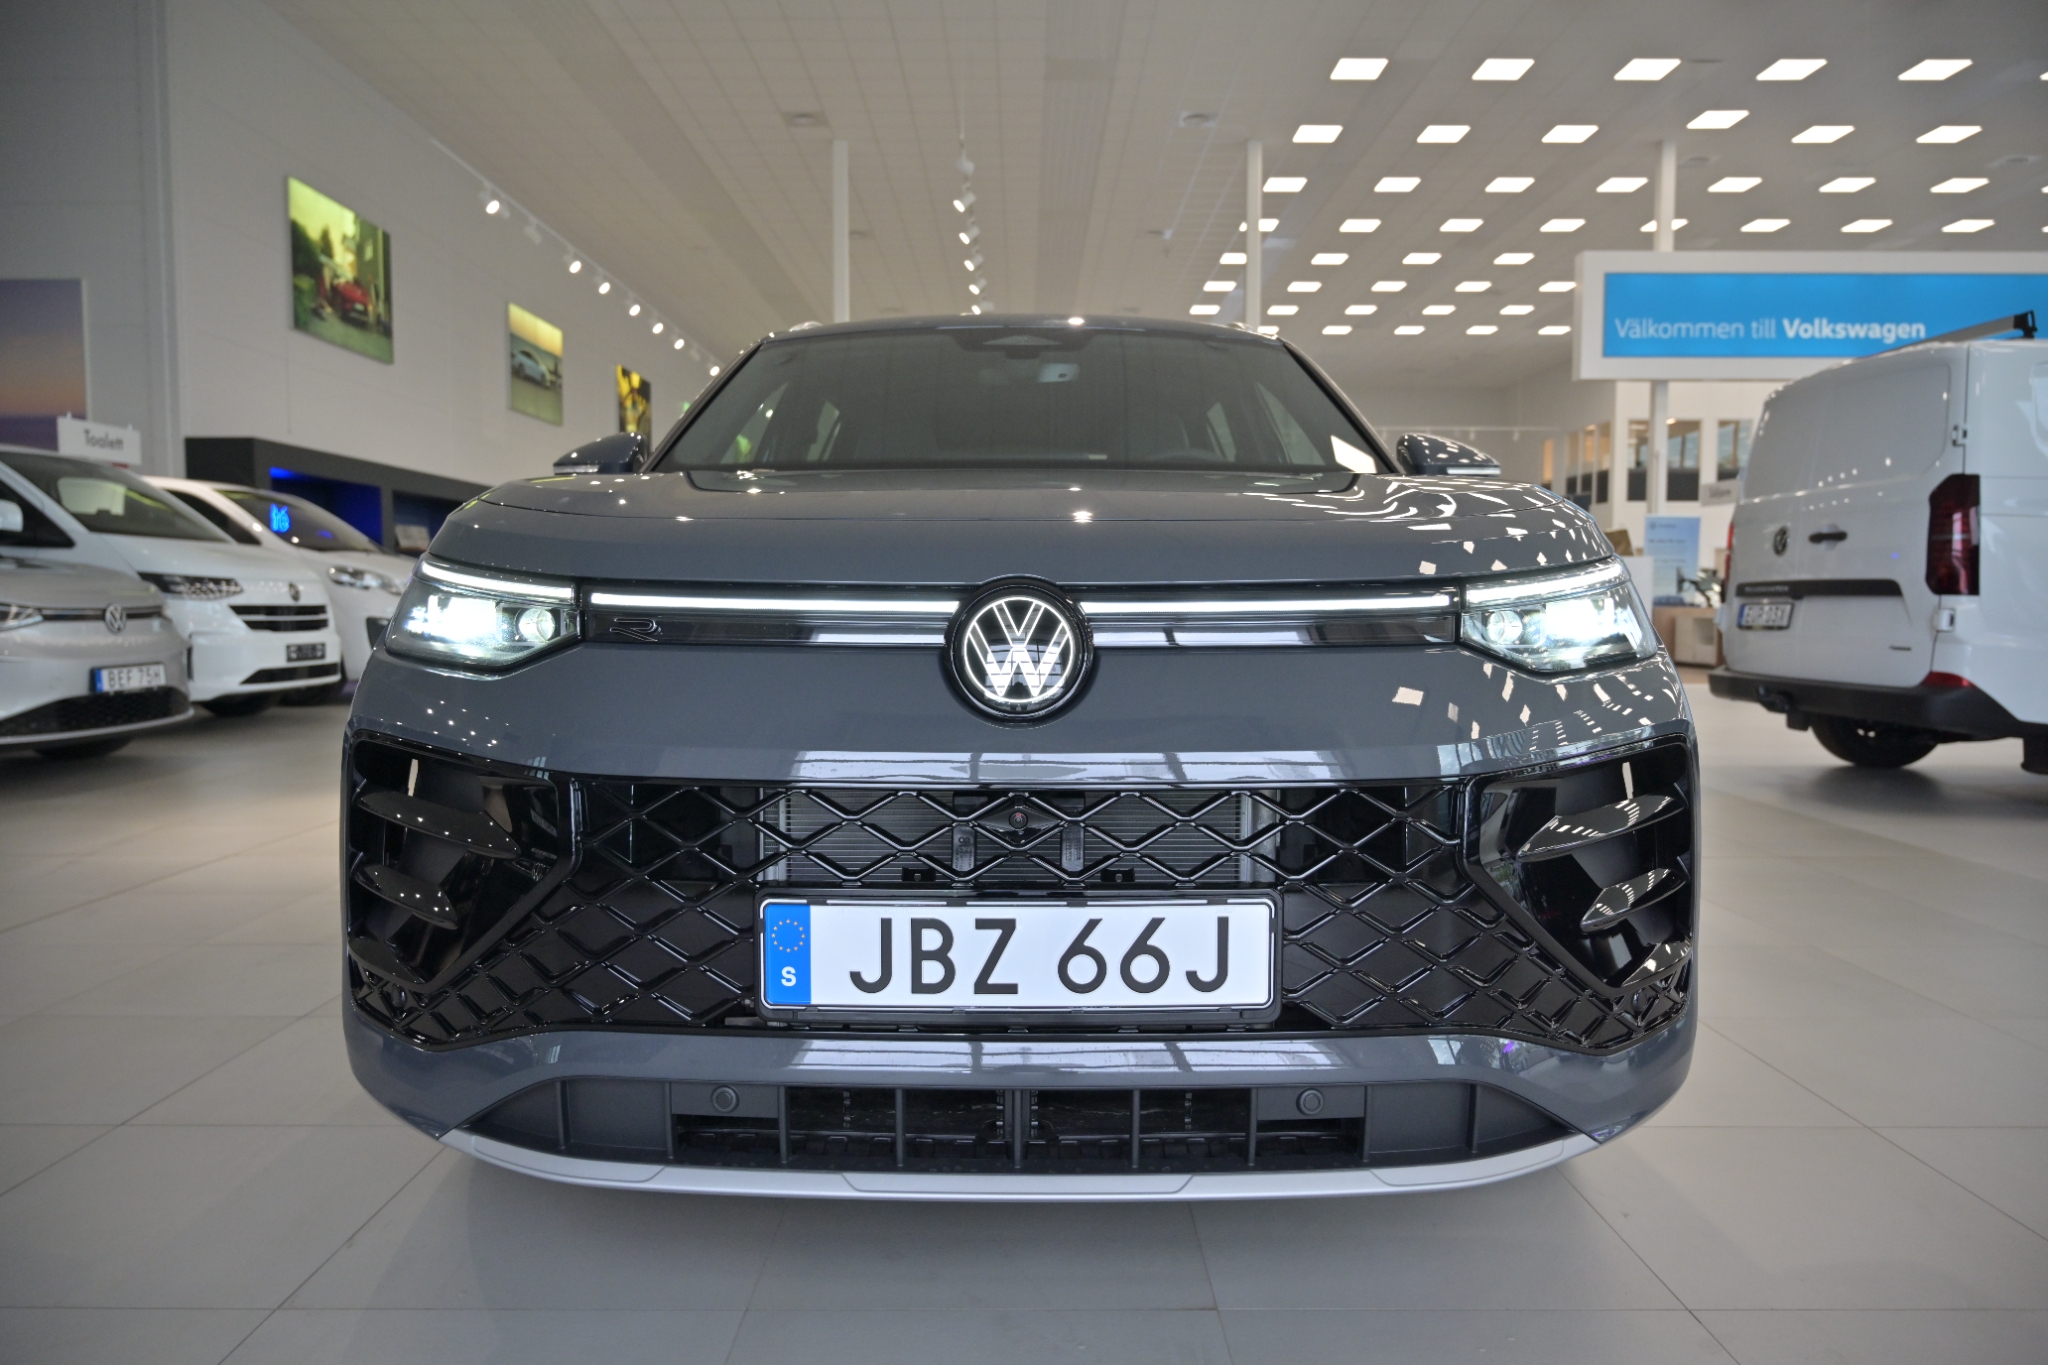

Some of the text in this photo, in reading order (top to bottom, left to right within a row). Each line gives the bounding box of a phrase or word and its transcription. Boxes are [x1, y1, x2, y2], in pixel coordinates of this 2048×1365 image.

[1614, 318, 1926, 343] Välkommen till Volkswagen
[84, 428, 124, 450] Toalett
[107, 669, 134, 689] BEF
[849, 916, 1229, 995] JBZ 66J
[780, 966, 797, 988] S
